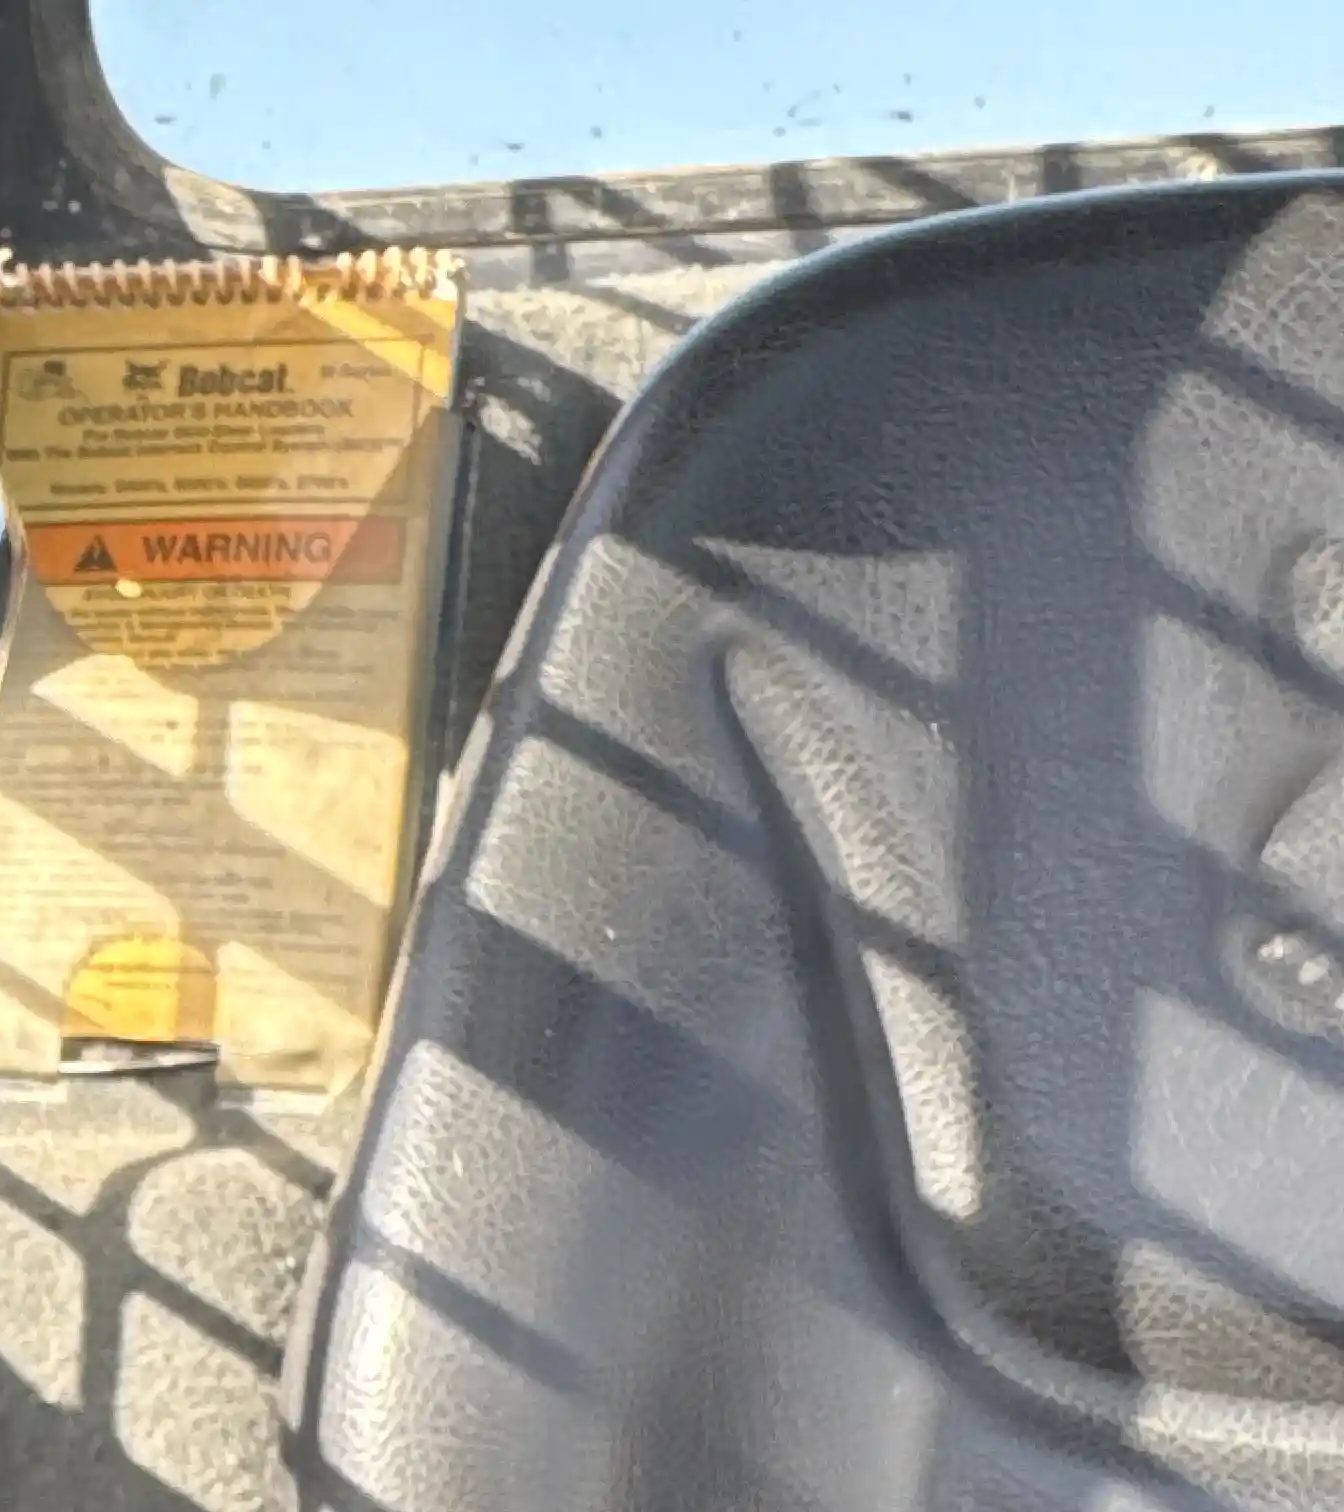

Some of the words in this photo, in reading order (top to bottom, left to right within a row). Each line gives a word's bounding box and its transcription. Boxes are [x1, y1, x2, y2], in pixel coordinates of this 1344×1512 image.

[57, 402, 206, 427] OPERATOR'S
[213, 398, 355, 420] HANDBOOK
[141, 531, 332, 565] WARNING
